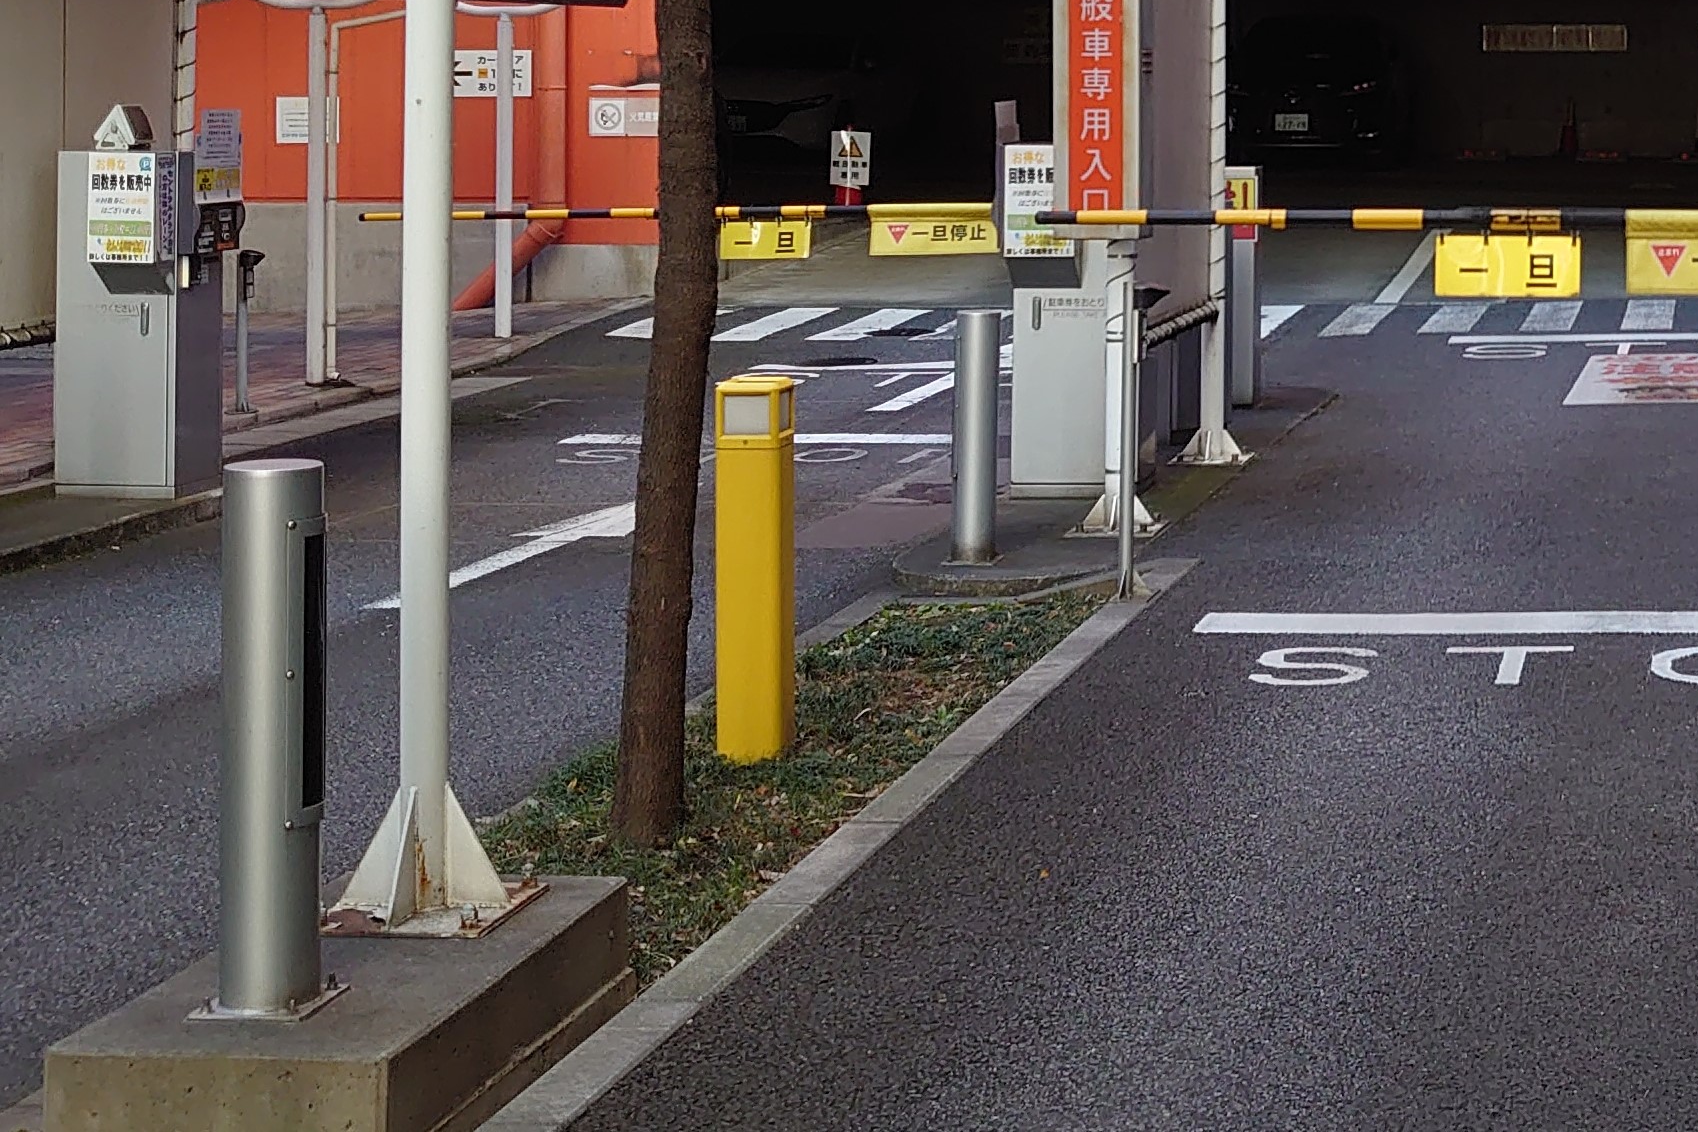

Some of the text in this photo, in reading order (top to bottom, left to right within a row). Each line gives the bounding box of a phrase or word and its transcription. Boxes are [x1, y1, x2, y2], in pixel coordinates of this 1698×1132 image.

[477, 56, 524, 64] カーア
[91, 174, 152, 191] 回数券を販売中
[911, 224, 987, 242] 一旦停止
[1459, 254, 1557, 288] 一旦
